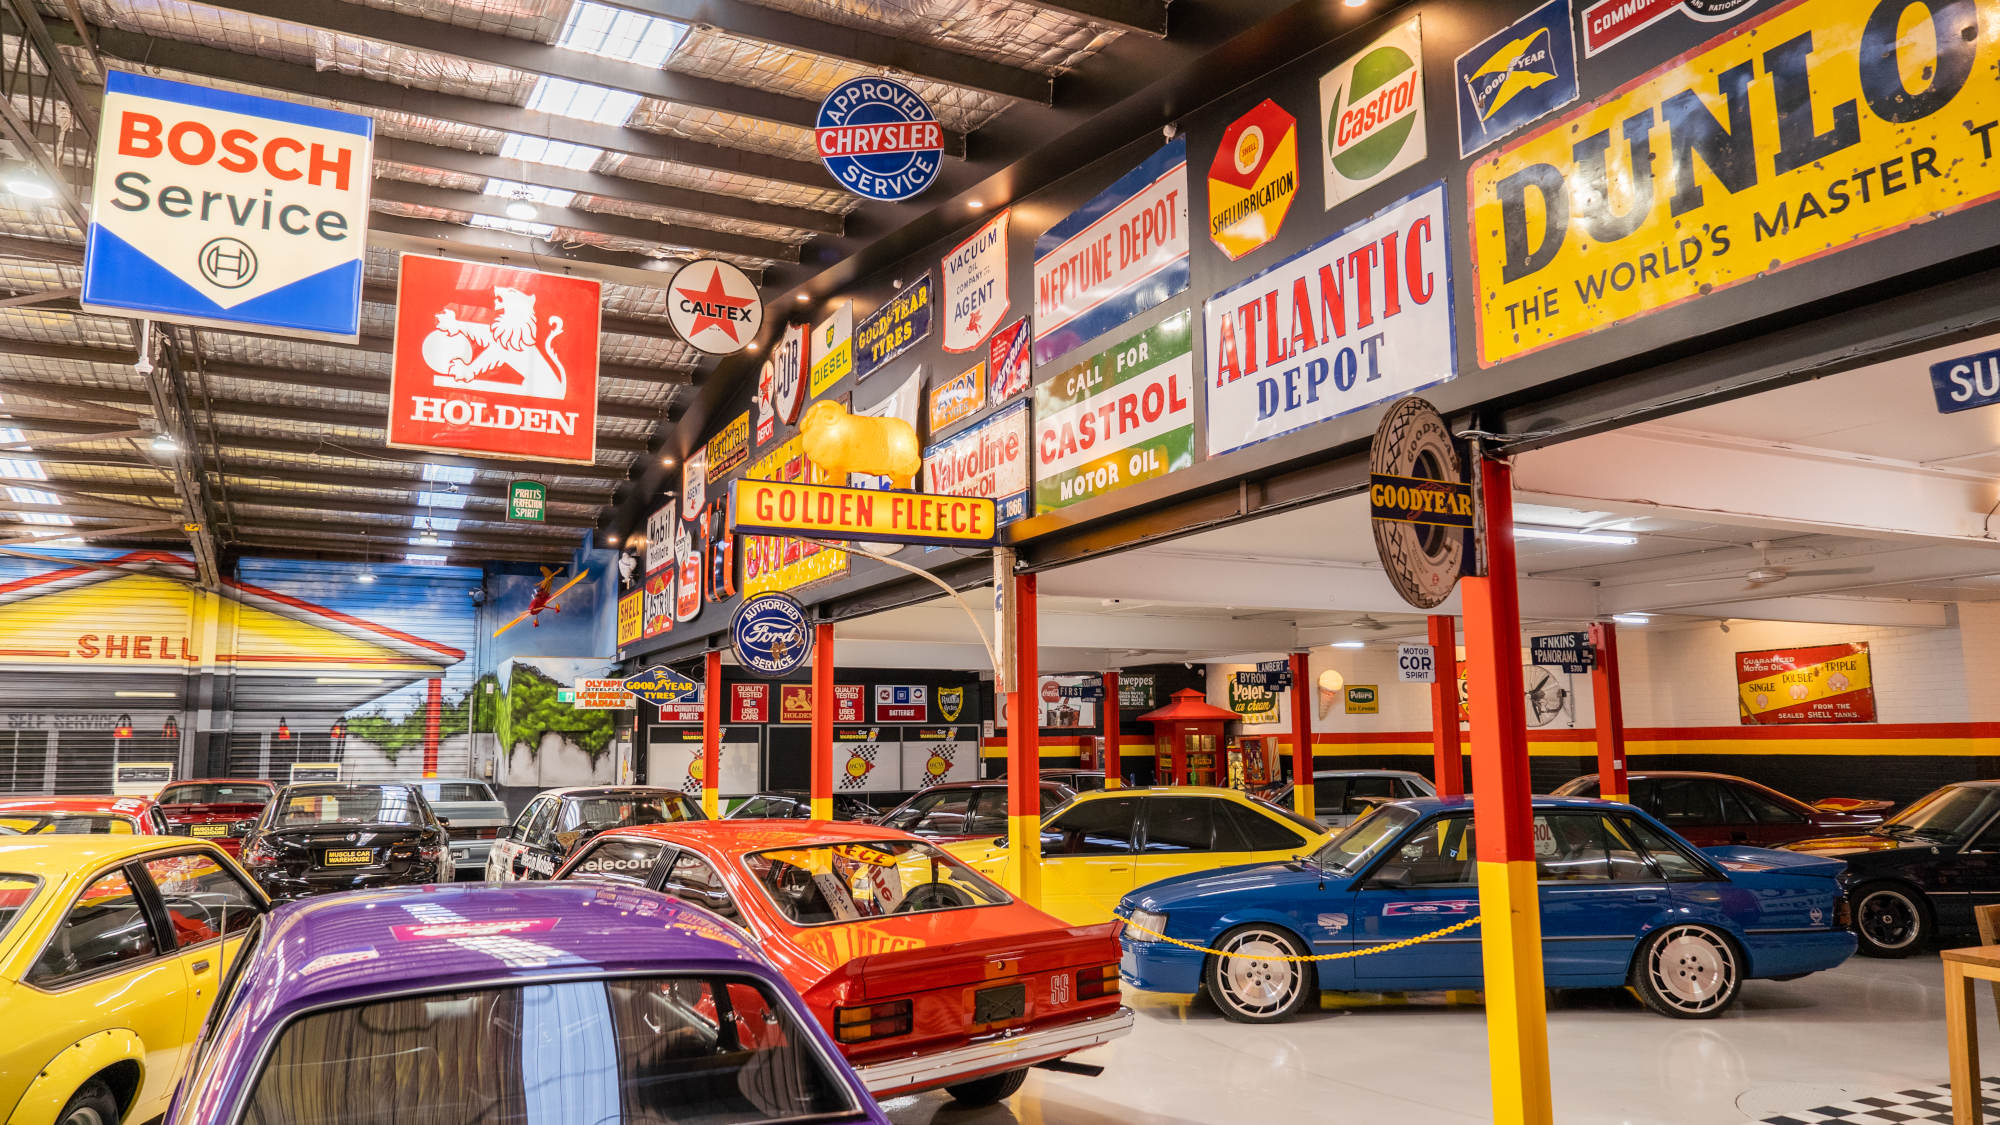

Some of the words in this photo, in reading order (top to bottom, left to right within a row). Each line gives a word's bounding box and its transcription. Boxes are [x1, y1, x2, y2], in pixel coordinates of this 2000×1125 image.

[826, 83, 925, 125] APPROVED
[1338, 71, 1417, 148] Castrol
[118, 110, 352, 191] BOSCH
[820, 125, 939, 153] CHRYSLER
[1242, 143, 1256, 158] SHELL
[842, 156, 934, 195] SERVICE
[110, 171, 349, 241] Service
[1212, 171, 1294, 236] SHELLUBRICATION
[950, 227, 997, 275] VACUUM
[1504, 288, 1560, 331] THE
[1575, 223, 1731, 304] WORLD'S
[1753, 146, 1942, 242] MASTER
[1039, 233, 1113, 318] NEPTUNE
[1119, 190, 1179, 272] DEPOT
[967, 263, 978, 274] OIL
[956, 272, 983, 295] COMPANY
[680, 299, 752, 323] CALTEX
[954, 279, 995, 322] AGENT
[1217, 215, 1434, 388] ATLANTIC
[872, 321, 912, 362] TYRES
[777, 339, 798, 398] COR
[813, 349, 847, 386] DIESEL
[1067, 364, 1103, 397] CALL
[1116, 341, 1149, 373] FOR
[1257, 332, 1385, 422] DEPOT
[937, 372, 977, 411] AVON
[410, 396, 580, 437] HOLDEN
[1040, 374, 1187, 465] CASTROL
[757, 421, 773, 442] DEPOT
[931, 432, 1019, 495] Valvoline
[1060, 468, 1118, 501] MOTOR
[1129, 448, 1160, 472] OIL
[980, 471, 996, 497] Oil
[515, 507, 539, 518] SPIRIT
[755, 487, 873, 527] GOLDEN
[891, 498, 982, 534] FLEECE
[1006, 497, 1022, 517] 1866
[1370, 483, 1473, 516] GOODYEAR
[620, 596, 640, 624] SHELL
[645, 582, 672, 627] CASTROL
[744, 600, 798, 622] AUTHORIZED
[621, 620, 637, 640] DEPOT
[745, 622, 797, 643] Ford
[77, 634, 199, 661] SHELL
[1403, 647, 1429, 655] MOTOR
[1537, 649, 1578, 663] PANORAMA
[752, 654, 794, 670] SERVICE
[1257, 661, 1284, 673] LAMBERT
[1405, 671, 1429, 679] SPIRIT
[1825, 660, 1857, 672] TRIPLE
[1118, 676, 1154, 688] hweppes
[1240, 672, 1267, 684] BYRON
[1748, 682, 1776, 693] SINGLE
[1782, 672, 1814, 684] DOUBLE
[576, 691, 598, 700] LOW
[644, 692, 676, 700] TYRES
[1060, 686, 1083, 697] FIRST
[1350, 690, 1373, 700] Peters
[8, 712, 47, 729] SELF
[662, 704, 673, 712] AIR
[674, 704, 704, 713] CONDITION
[679, 712, 699, 720] PARTS
[1808, 711, 1832, 719] SHELL
[1051, 973, 1069, 1005] SS
